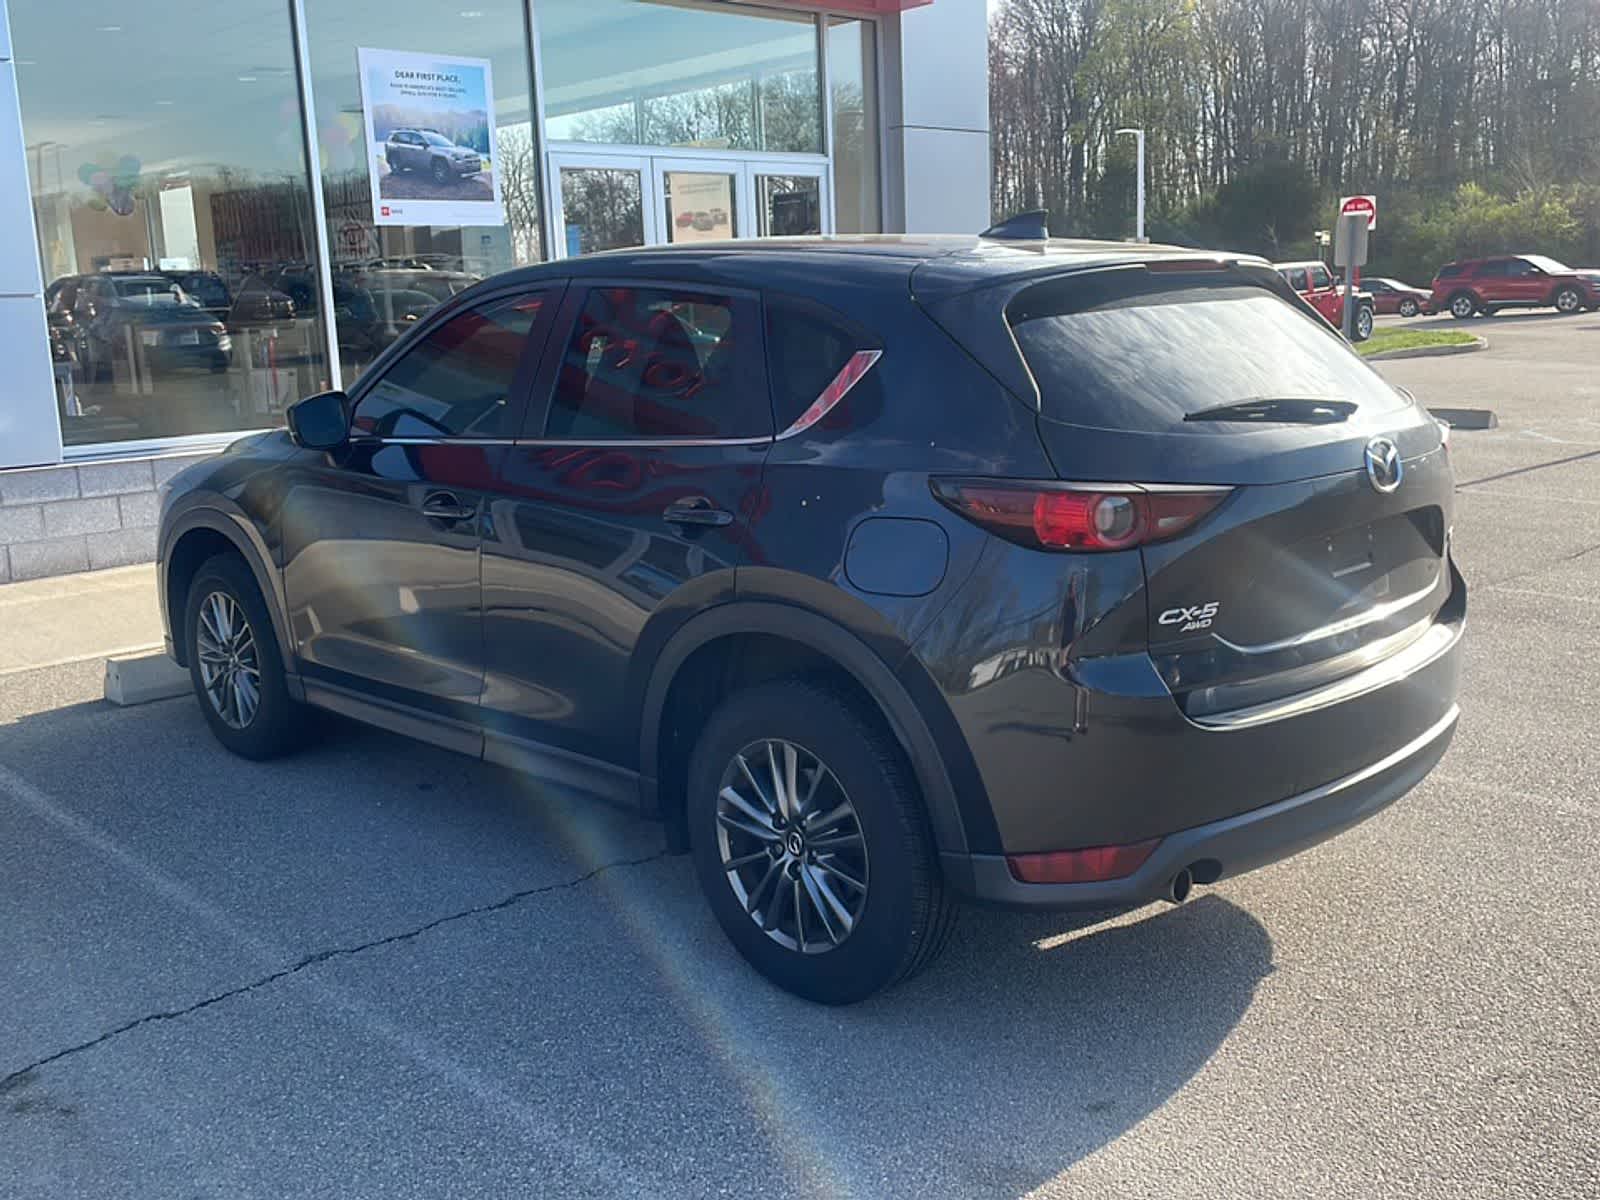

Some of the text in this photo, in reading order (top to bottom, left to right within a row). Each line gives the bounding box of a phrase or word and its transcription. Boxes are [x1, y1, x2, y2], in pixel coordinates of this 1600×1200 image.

[394, 70, 414, 79] DEAR
[416, 72, 436, 81] FIRST
[1158, 601, 1220, 625] CX-5
[1180, 618, 1212, 633] AWD
